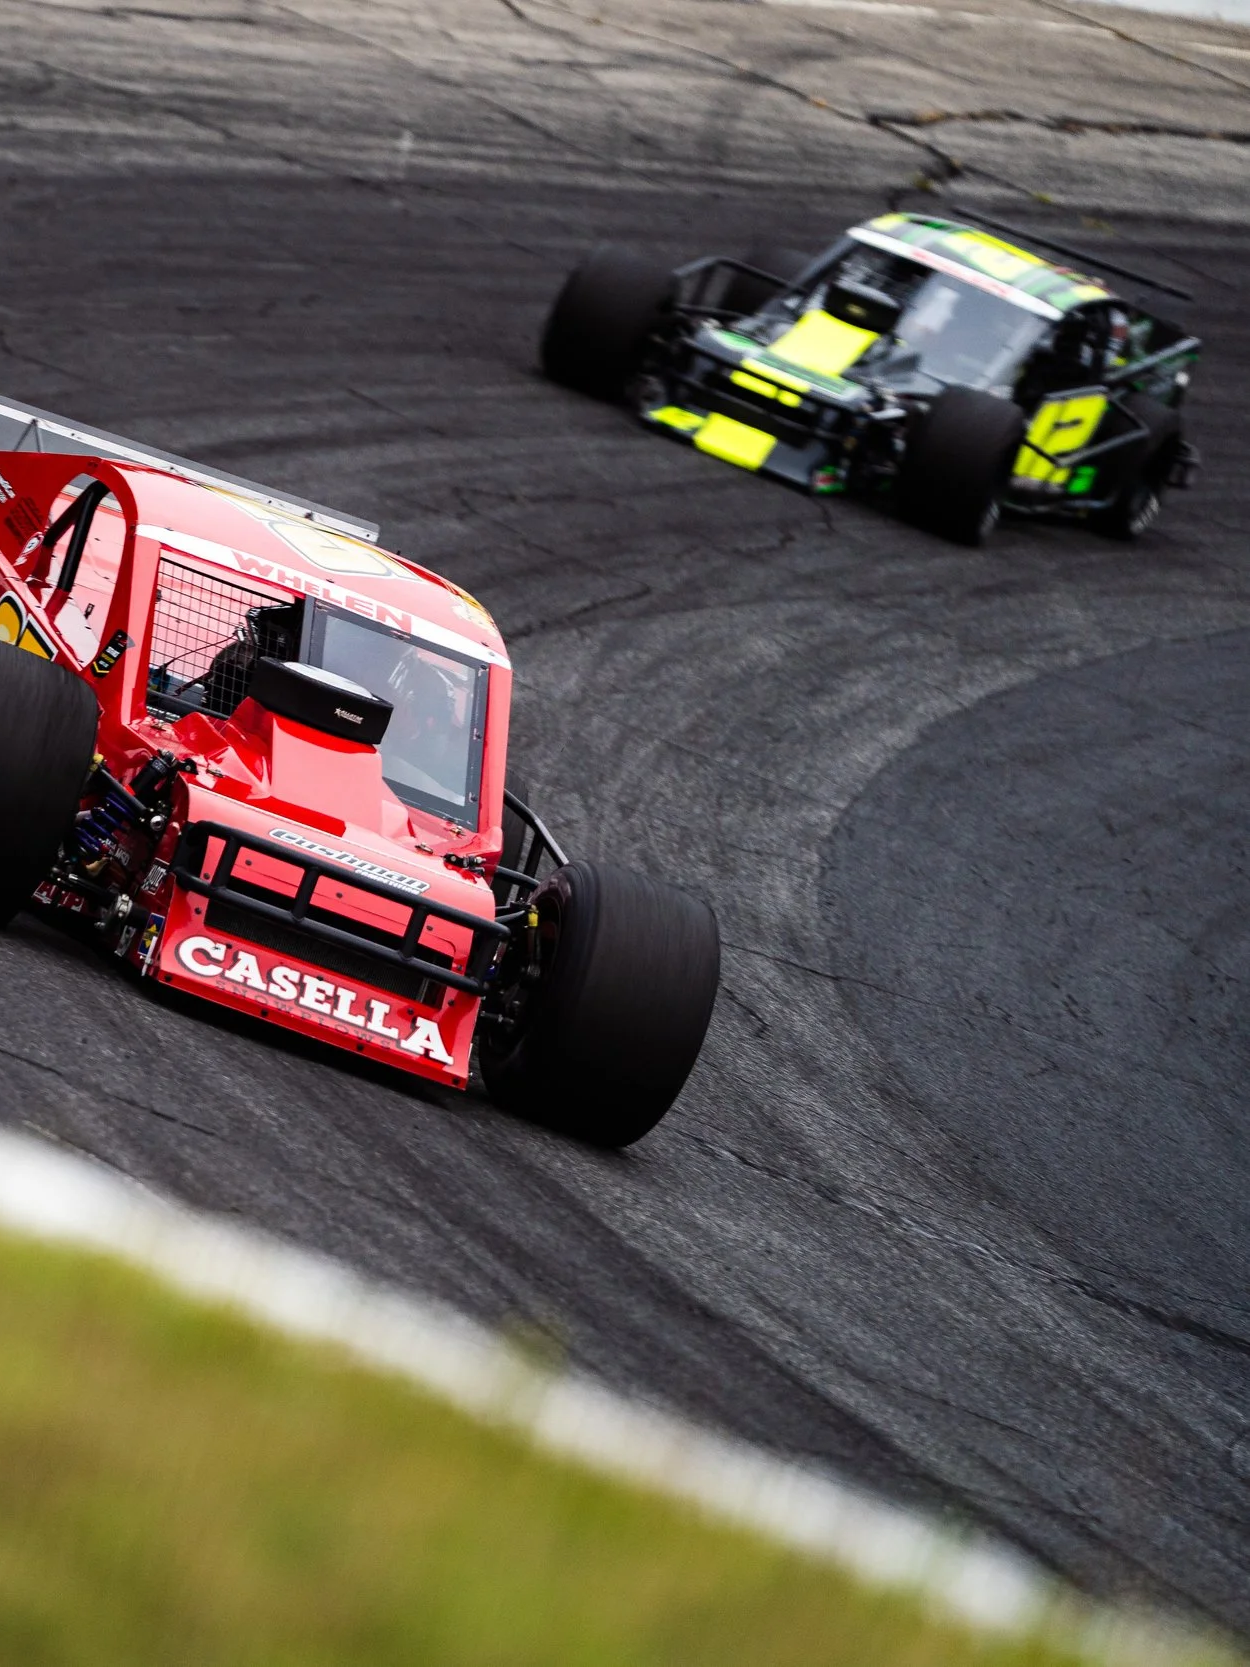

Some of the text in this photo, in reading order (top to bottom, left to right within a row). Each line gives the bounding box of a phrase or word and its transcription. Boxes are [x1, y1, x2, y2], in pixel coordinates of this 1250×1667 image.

[231, 550, 412, 634] WHELEN
[269, 828, 431, 893] Cushman
[178, 936, 454, 1065] CASELLA
